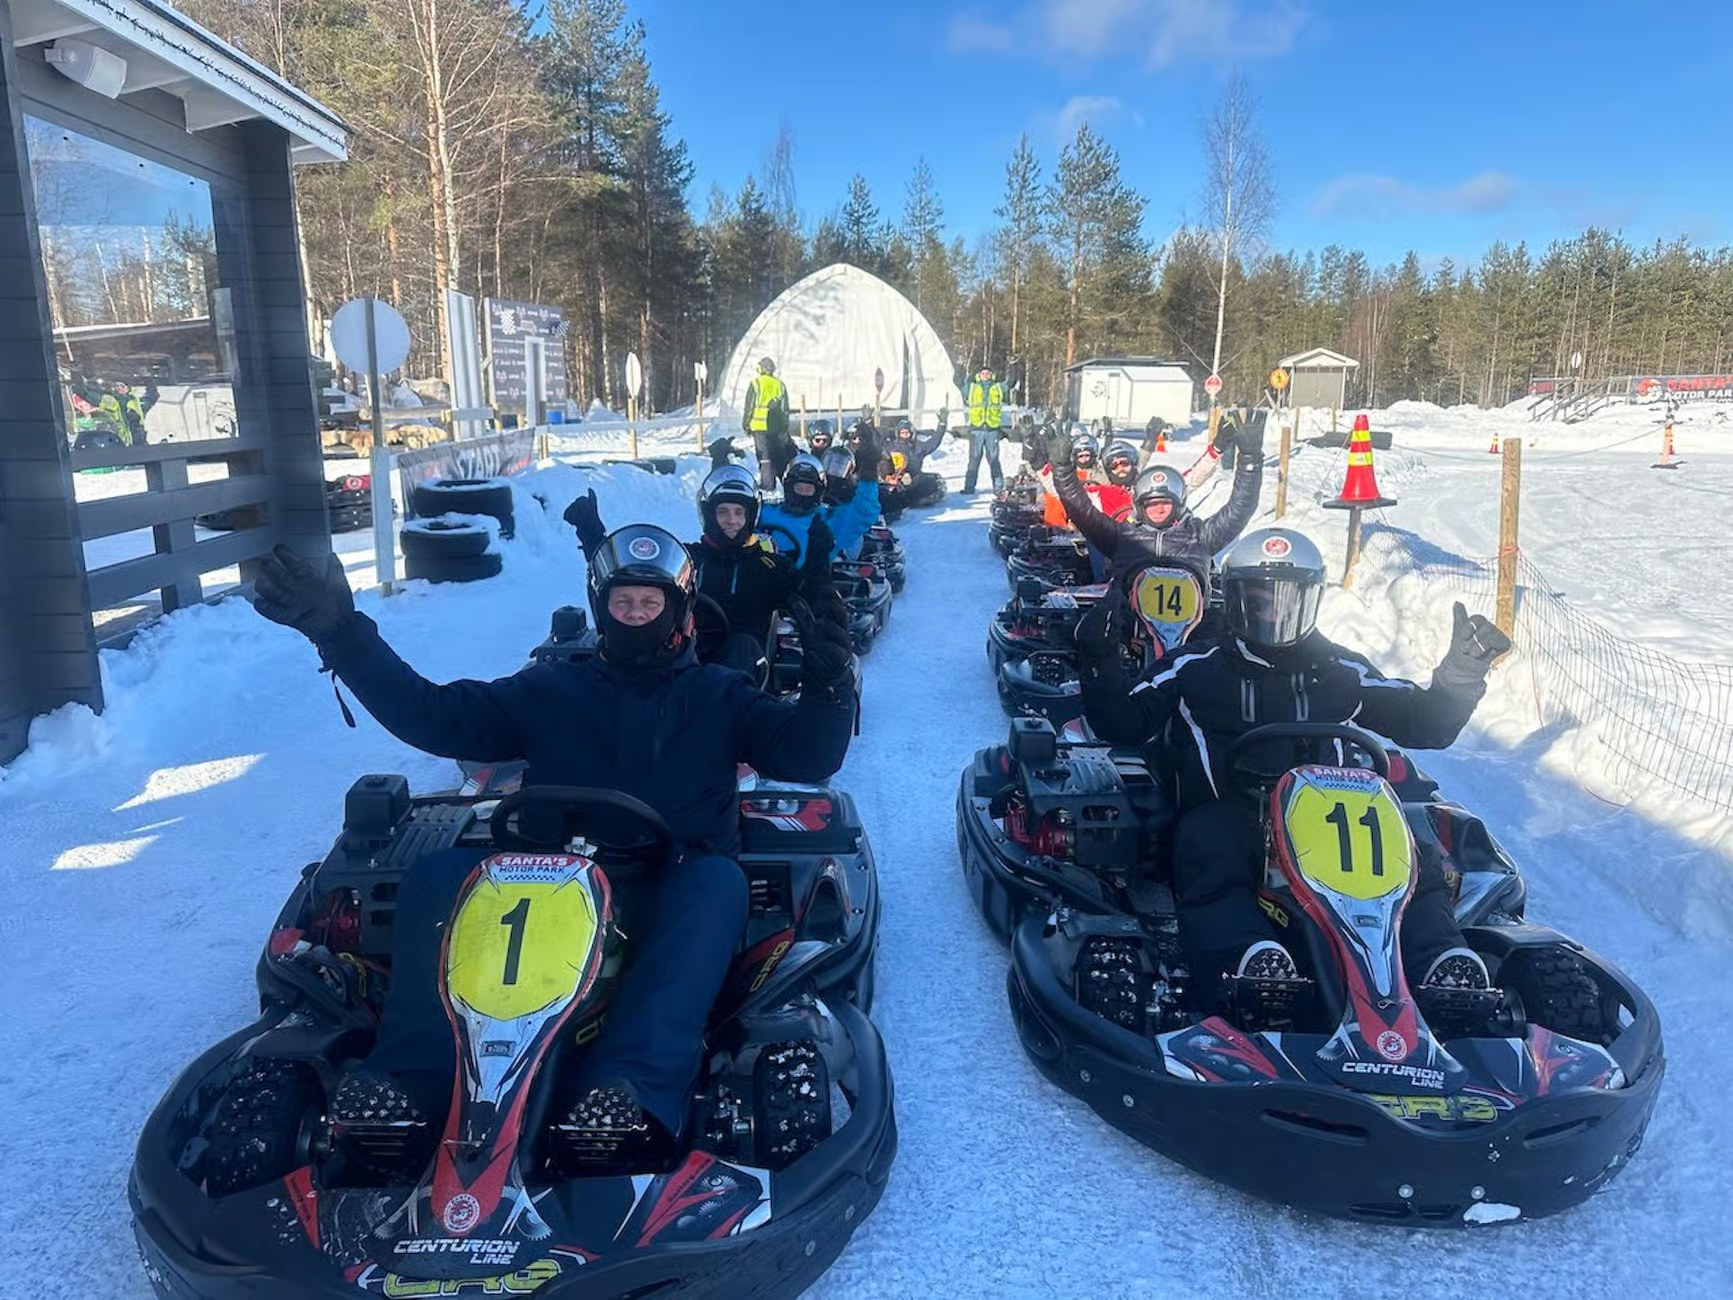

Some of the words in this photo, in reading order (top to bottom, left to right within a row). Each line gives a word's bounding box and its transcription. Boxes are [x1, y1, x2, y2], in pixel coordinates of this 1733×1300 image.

[1708, 389, 1733, 398] PAR
[1154, 584, 1182, 616] 14
[1325, 802, 1384, 877] 11
[501, 857, 567, 866] SANTA'S
[536, 866, 565, 874] PARK
[500, 897, 532, 985] 1
[1342, 1062, 1445, 1081] CENTURION
[1411, 1077, 1444, 1089] LINE
[393, 1239, 520, 1254] CENTURION
[469, 1253, 514, 1265] LINE
